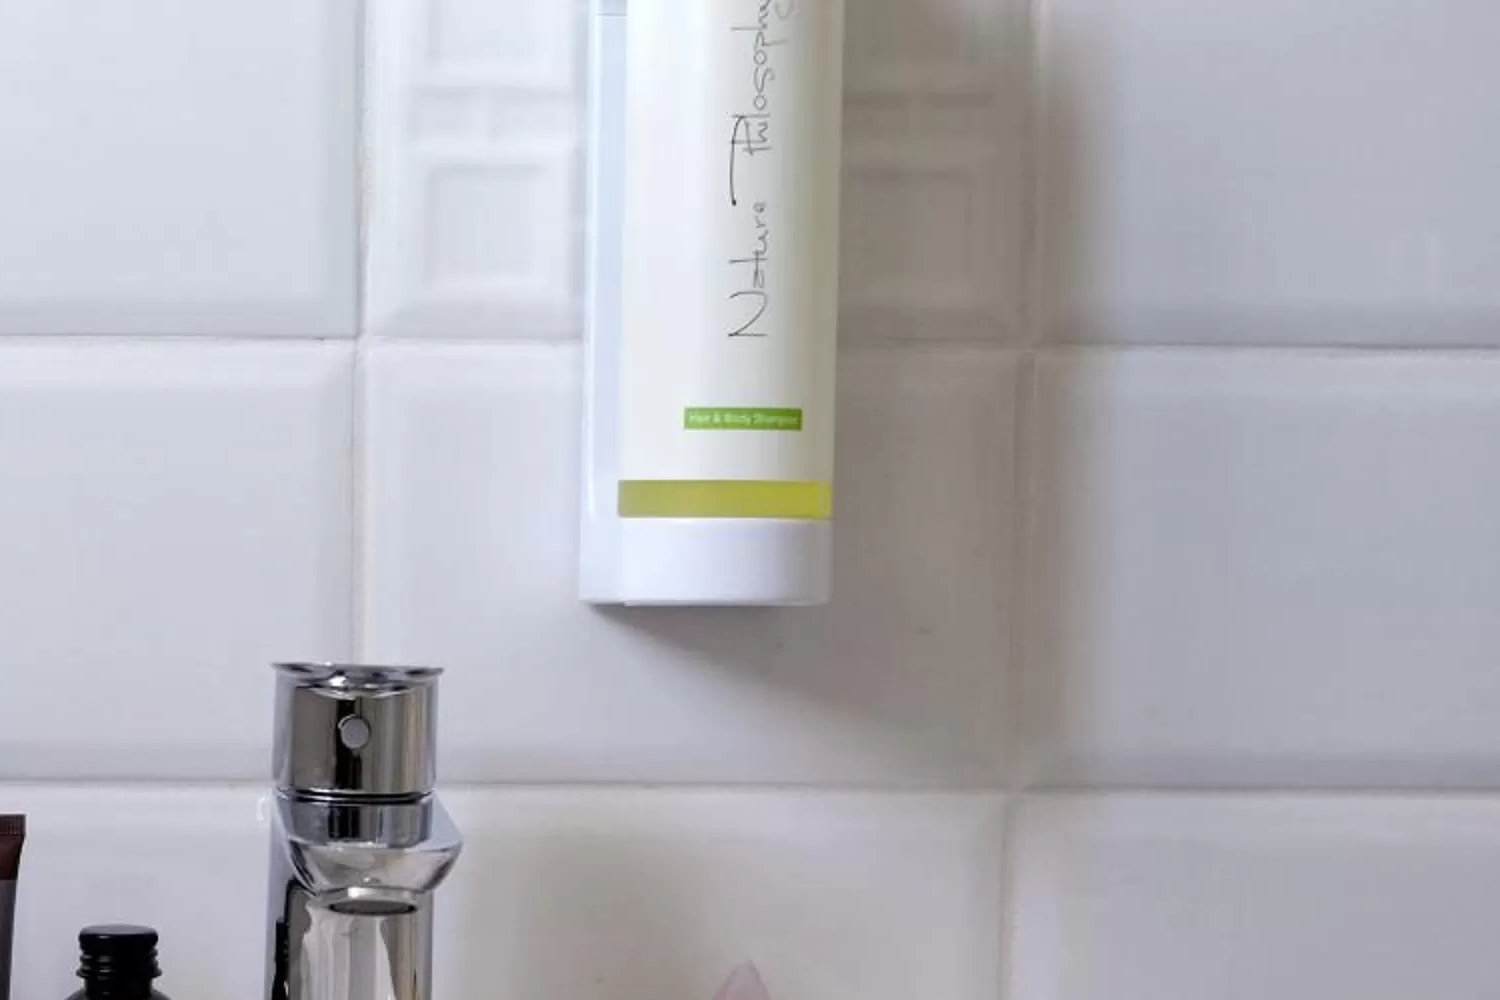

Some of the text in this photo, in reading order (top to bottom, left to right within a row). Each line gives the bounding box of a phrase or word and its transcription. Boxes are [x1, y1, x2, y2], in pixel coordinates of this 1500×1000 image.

[728, 201, 768, 337] Nature
[689, 411, 710, 424] Hair
[713, 411, 720, 424] &
[723, 411, 750, 427] Body
